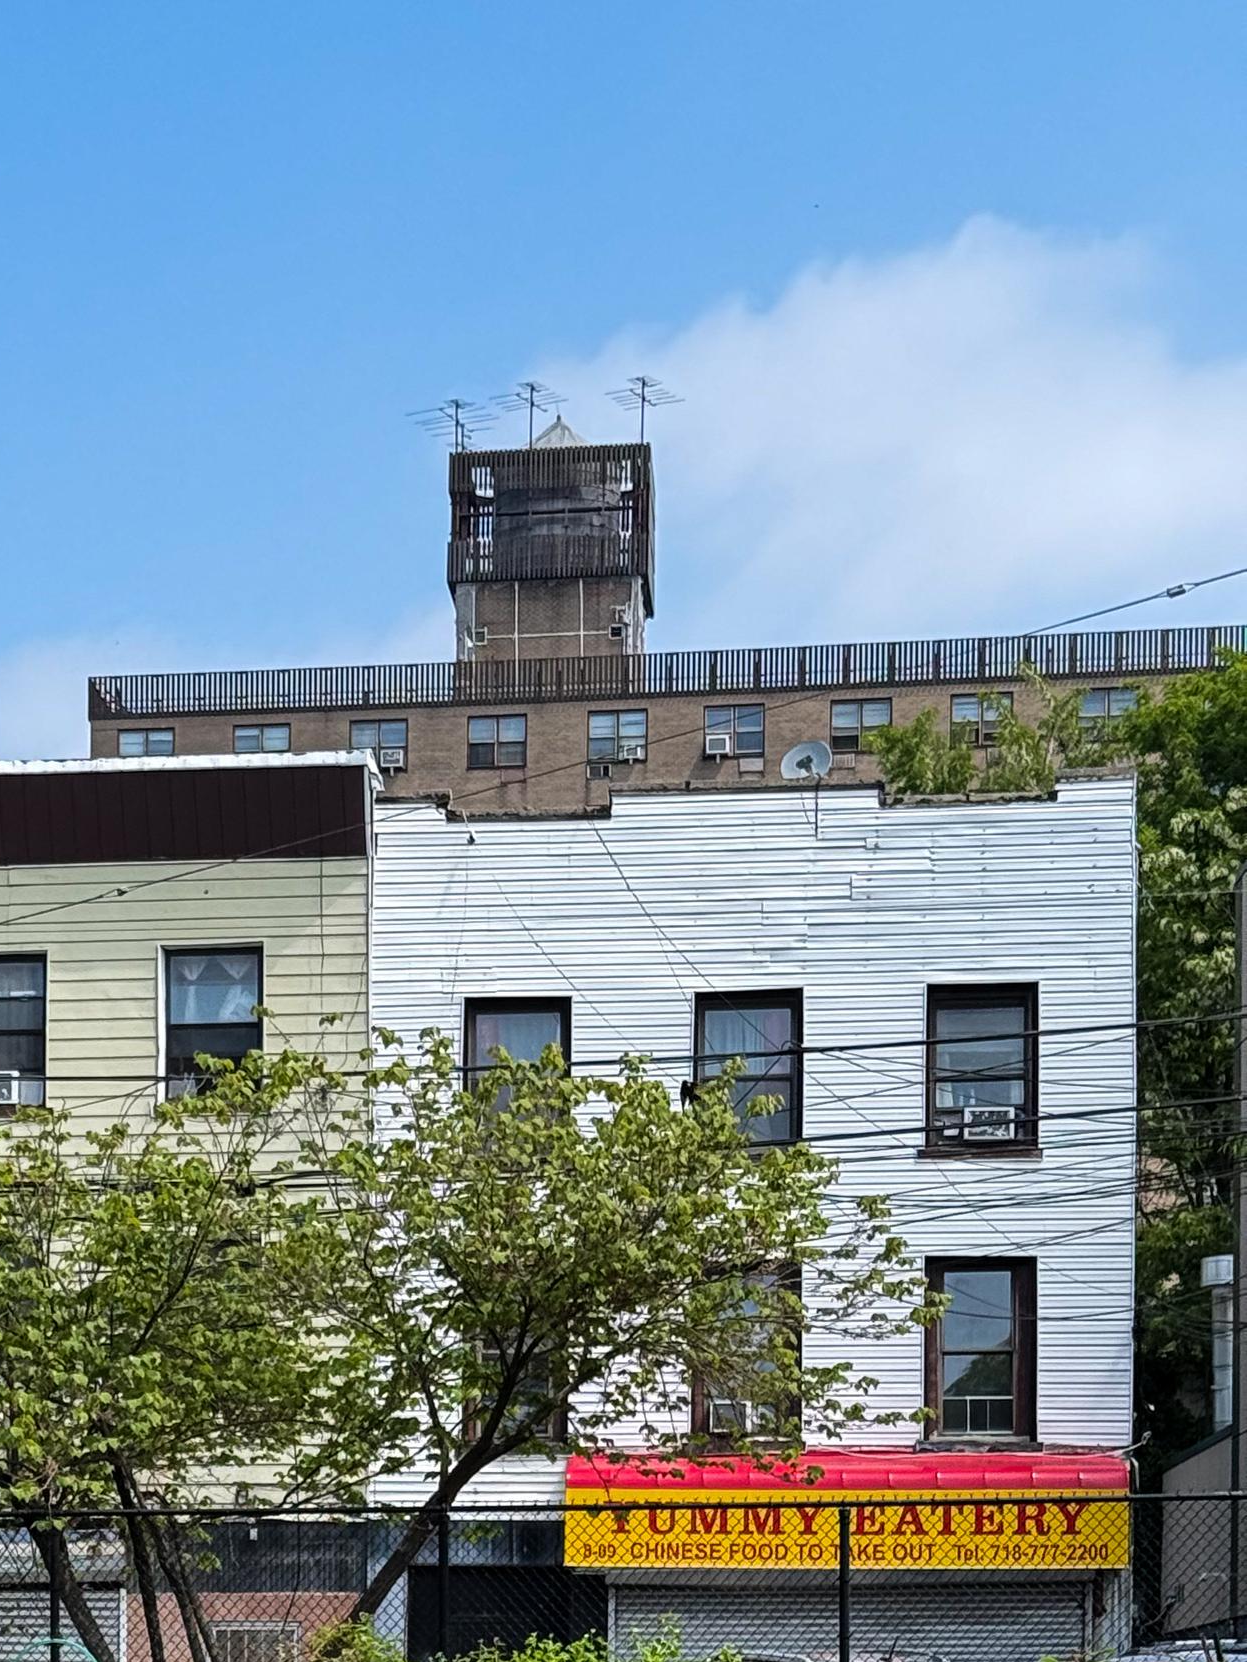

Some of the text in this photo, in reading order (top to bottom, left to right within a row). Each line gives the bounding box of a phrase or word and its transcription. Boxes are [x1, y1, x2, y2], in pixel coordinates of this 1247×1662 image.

[604, 1501, 1090, 1536] YUMMY EATERY
[630, 1542, 723, 1561] CHINESE
[729, 1542, 788, 1561] FOOD
[796, 1542, 823, 1561] TO
[893, 1542, 936, 1561] OUT
[955, 1544, 984, 1561] Tel:
[991, 1543, 1109, 1561] 718-777-2200
